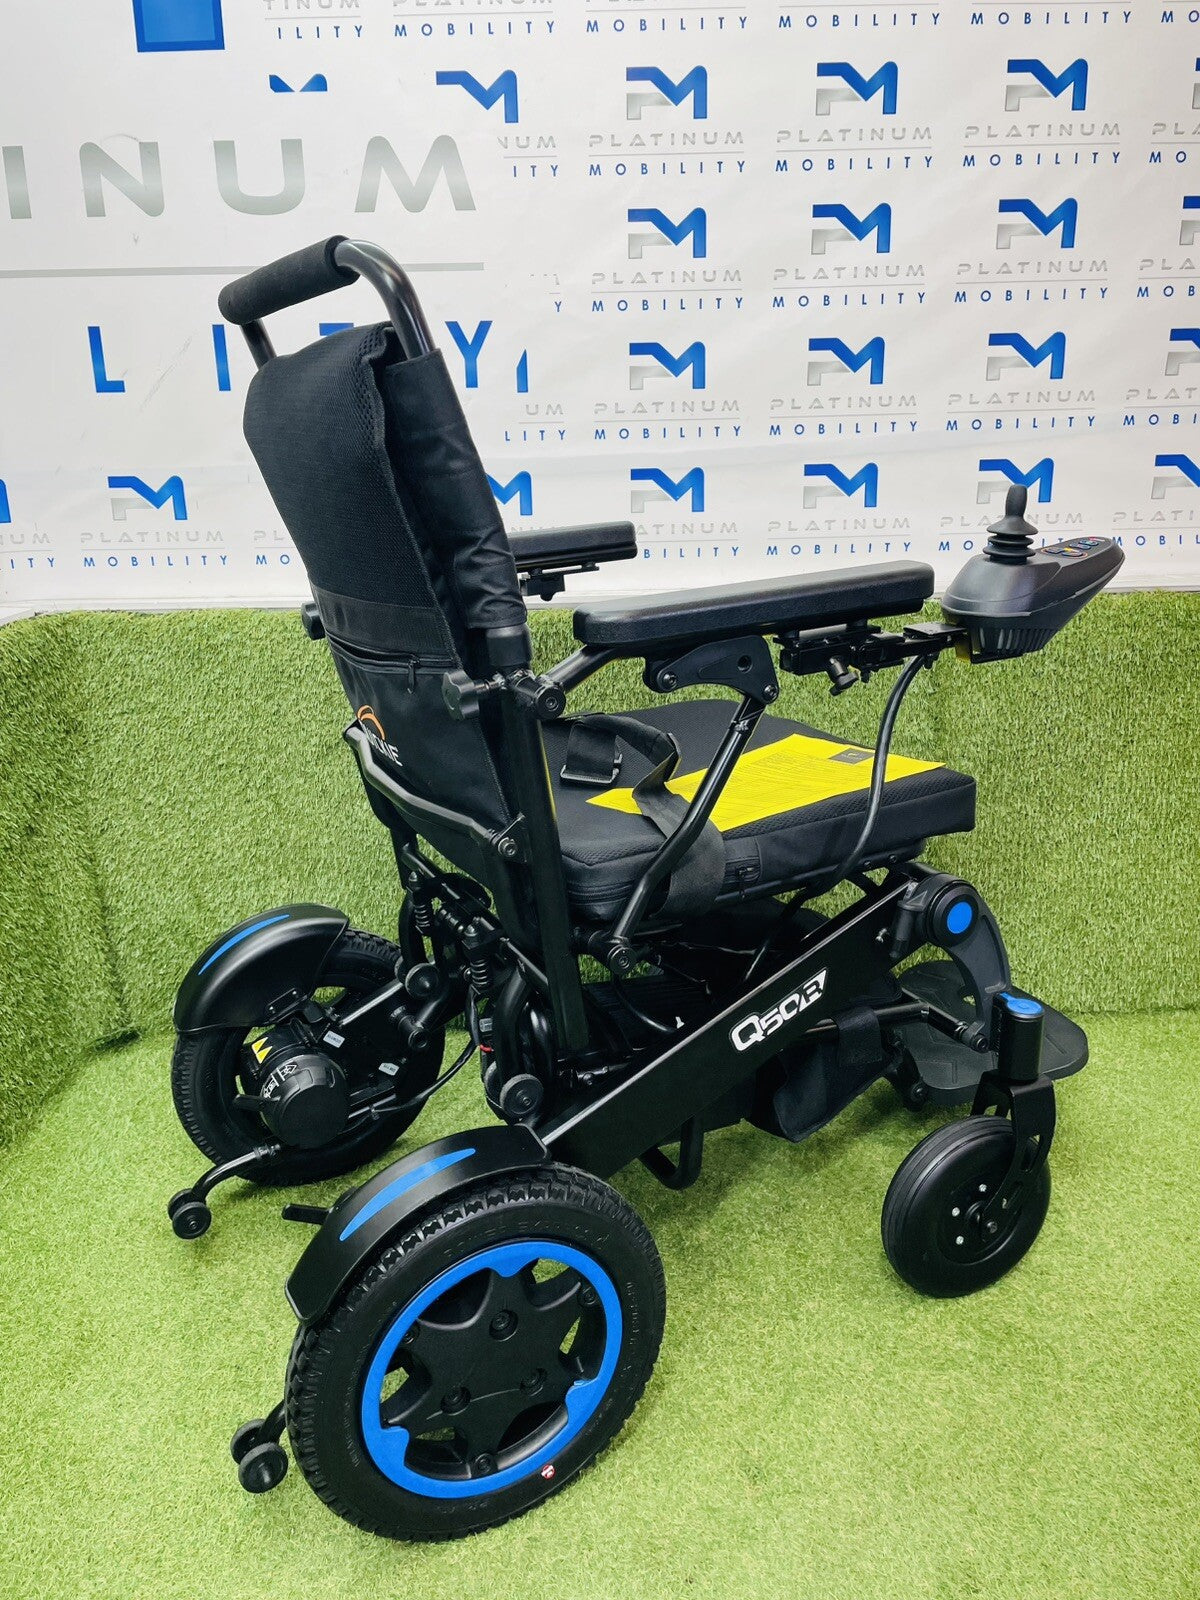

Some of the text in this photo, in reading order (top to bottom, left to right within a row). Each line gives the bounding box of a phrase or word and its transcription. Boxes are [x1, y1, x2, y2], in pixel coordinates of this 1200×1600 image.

[586, 16, 747, 33] MOBILITY
[779, 13, 940, 28] MOBILITY
[971, 11, 1131, 25] MOBILITY
[394, 21, 554, 37] MOBILITY
[777, 127, 931, 143] PLATINUM
[965, 123, 1120, 138] PLATINUM
[589, 132, 743, 147] PLATINUM
[775, 156, 932, 172] MOBILITY
[963, 152, 1120, 167] MOBILITY
[1149, 151, 1186, 163] MO
[513, 165, 558, 177] ITY
[589, 161, 745, 176] MOBILITY
[2, 134, 477, 220] INUM
[957, 260, 1107, 275] PLATINUM
[1140, 258, 1195, 270] PLA
[592, 270, 741, 284] PLATINUM
[774, 265, 924, 280] PLATINUM
[954, 287, 1108, 303] MOBILITY
[1137, 285, 1195, 297] MOB
[592, 297, 743, 312] MOBILITY
[773, 292, 925, 308] MOBILITY
[87, 320, 492, 394] LIY
[771, 395, 916, 410] PLATINUM
[948, 390, 1095, 405] PLATINUM
[594, 400, 739, 414] PLATINUM
[946, 416, 1095, 431] MOBILITY
[1123, 413, 1197, 426] MOBI
[595, 426, 741, 440] MOBILITY
[769, 421, 917, 435] MOBILITY
[505, 430, 566, 442] LITY
[768, 518, 910, 532] PLATINUM
[938, 510, 1084, 530] PLANUM
[81, 531, 223, 543] PLATINUM
[644, 546, 739, 559] BILITY
[766, 542, 911, 555] MOBILITY
[84, 555, 227, 567] MOBILITY
